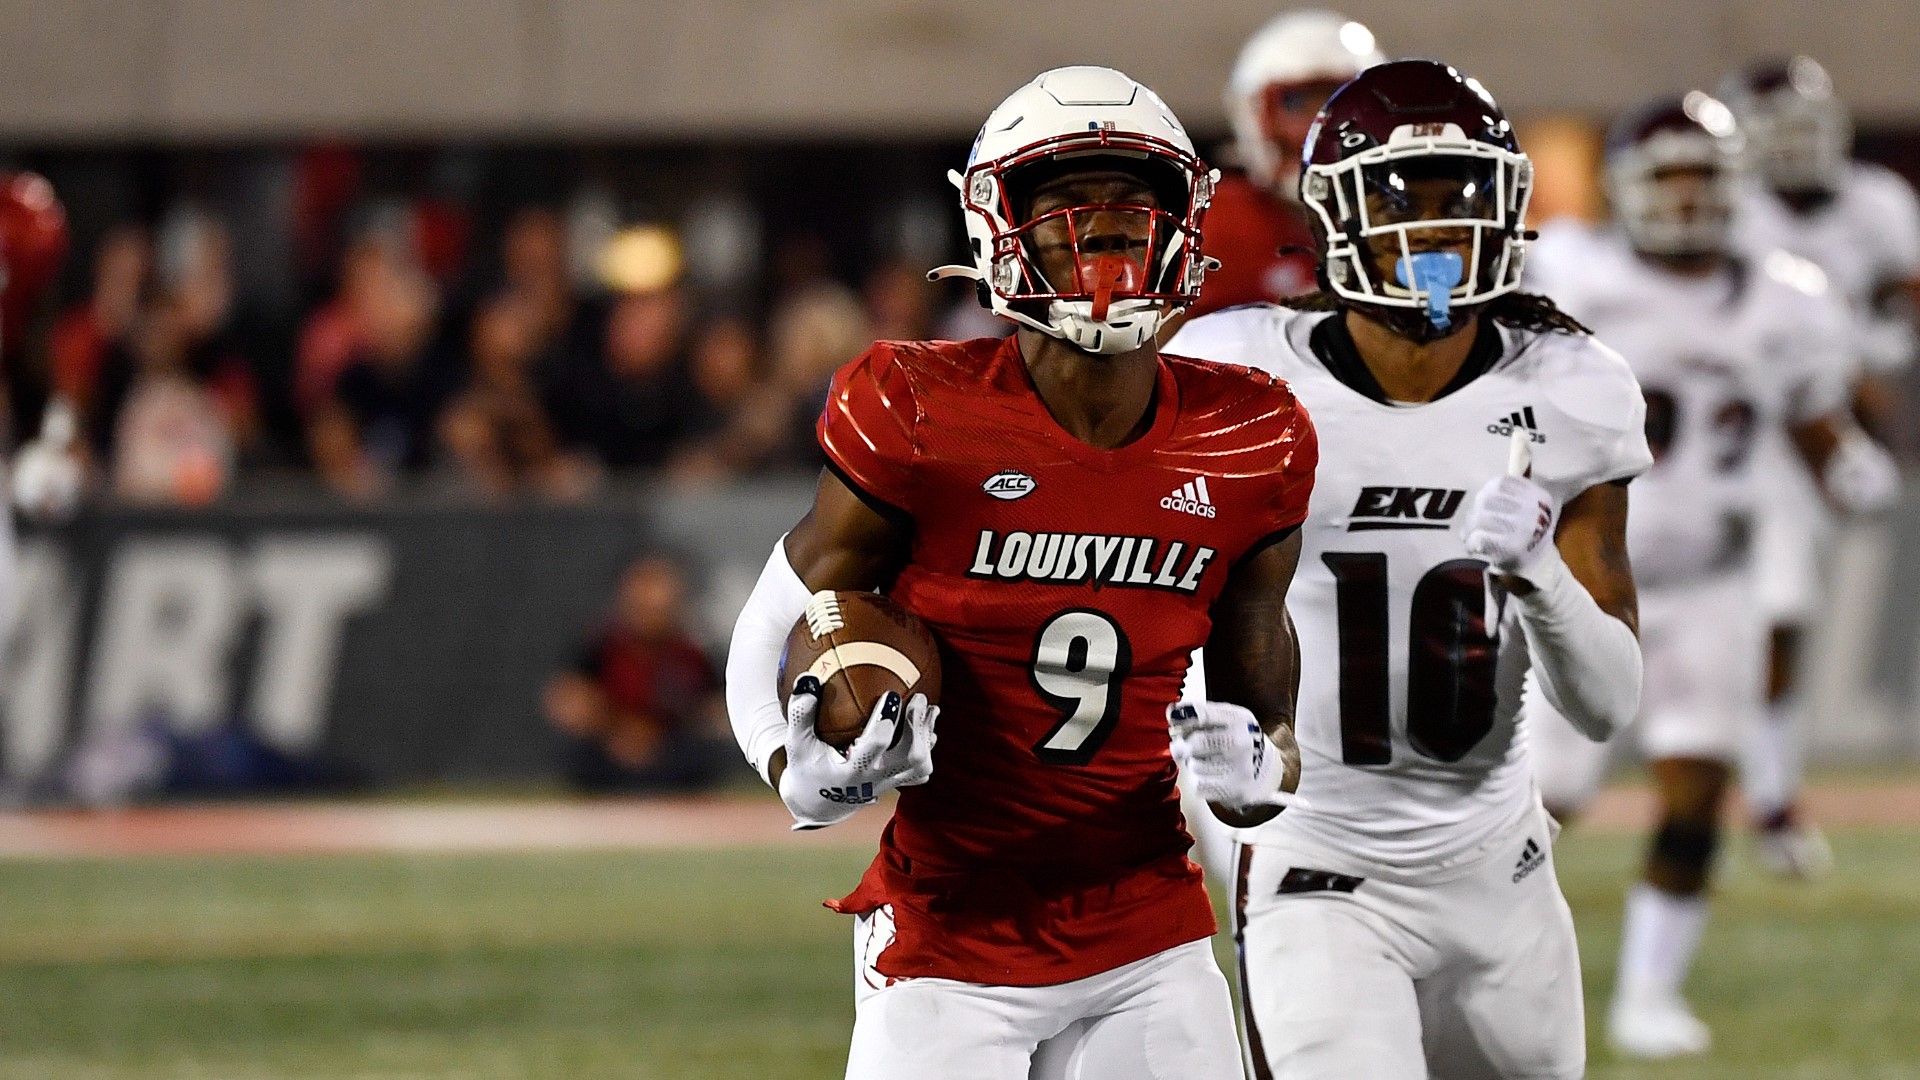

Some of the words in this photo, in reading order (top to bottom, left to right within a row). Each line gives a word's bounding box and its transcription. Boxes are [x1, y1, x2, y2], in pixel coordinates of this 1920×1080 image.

[1486, 422, 1546, 444] adas
[988, 477, 1031, 489] ACC
[1160, 496, 1216, 518] adidas
[1348, 486, 1467, 519] EKU
[968, 530, 1215, 592] LOUISVILLE
[1321, 551, 1500, 766] 10
[1033, 611, 1120, 754] 9
[819, 788, 878, 804] adid
